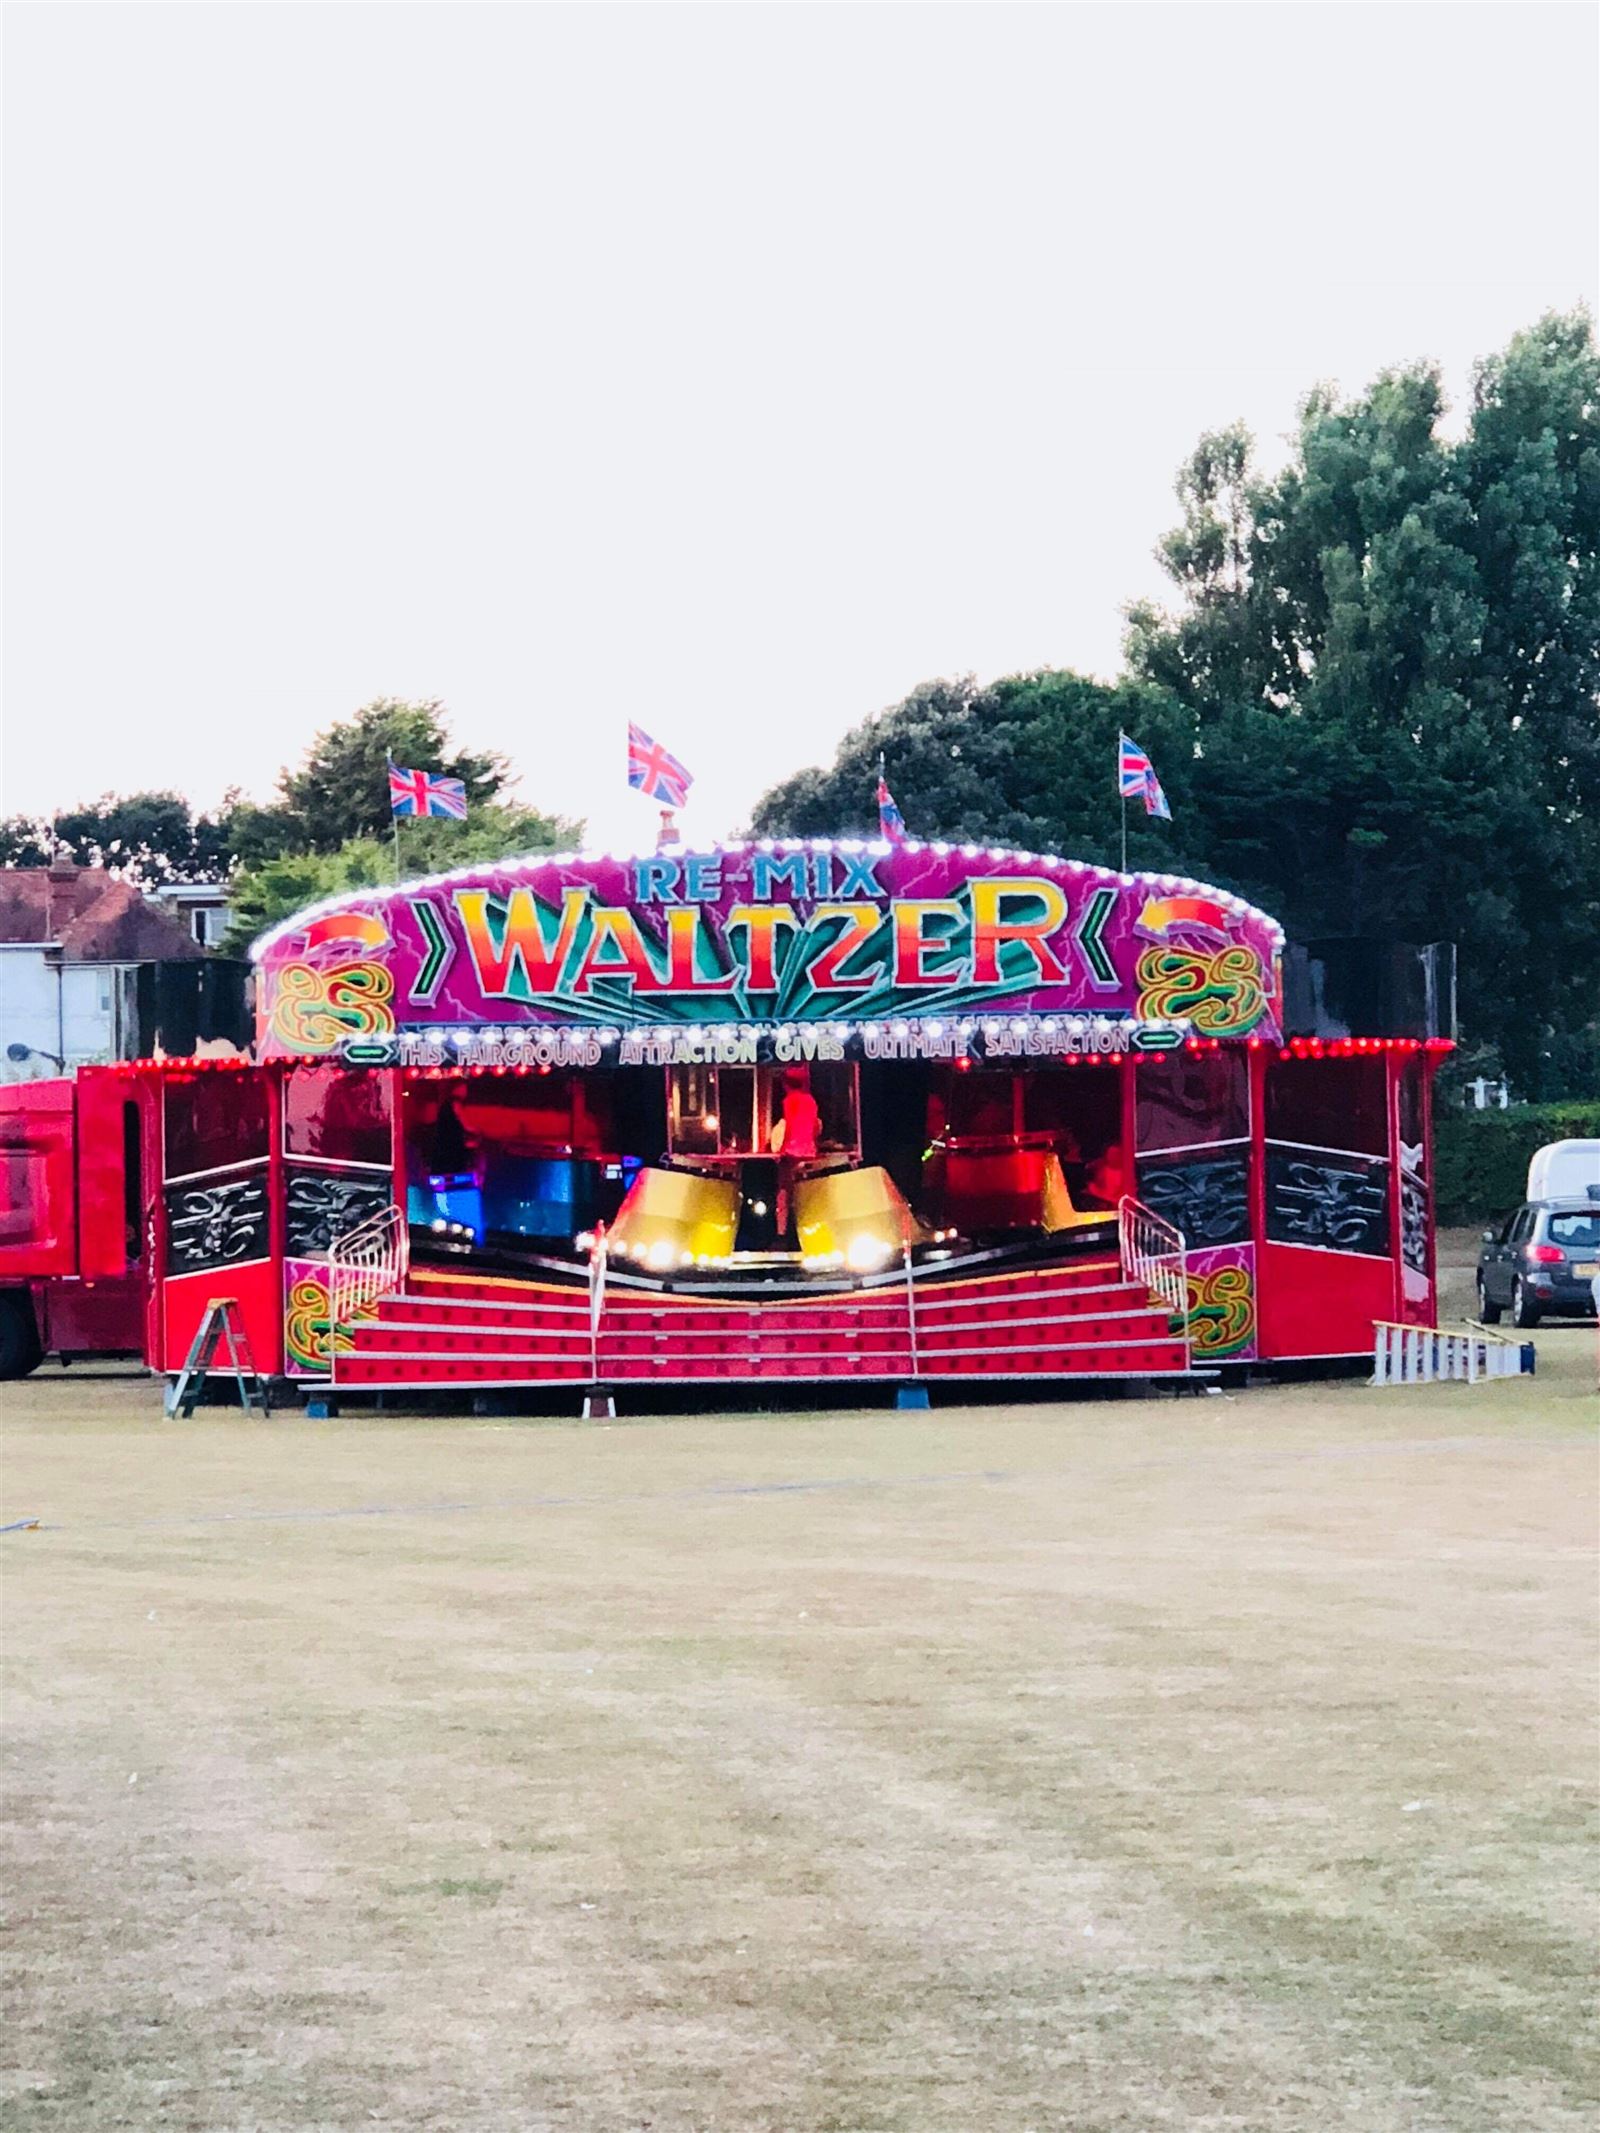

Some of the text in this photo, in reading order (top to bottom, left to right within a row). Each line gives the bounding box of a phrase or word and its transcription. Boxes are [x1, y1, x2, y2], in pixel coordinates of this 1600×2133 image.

[634, 851, 887, 905] RE-MIX
[453, 875, 1071, 998] WALTZER
[399, 1028, 1130, 1067] THIS FAIRGROUND ATTRACTION GIVES ULTIMATE SATISFACTION
